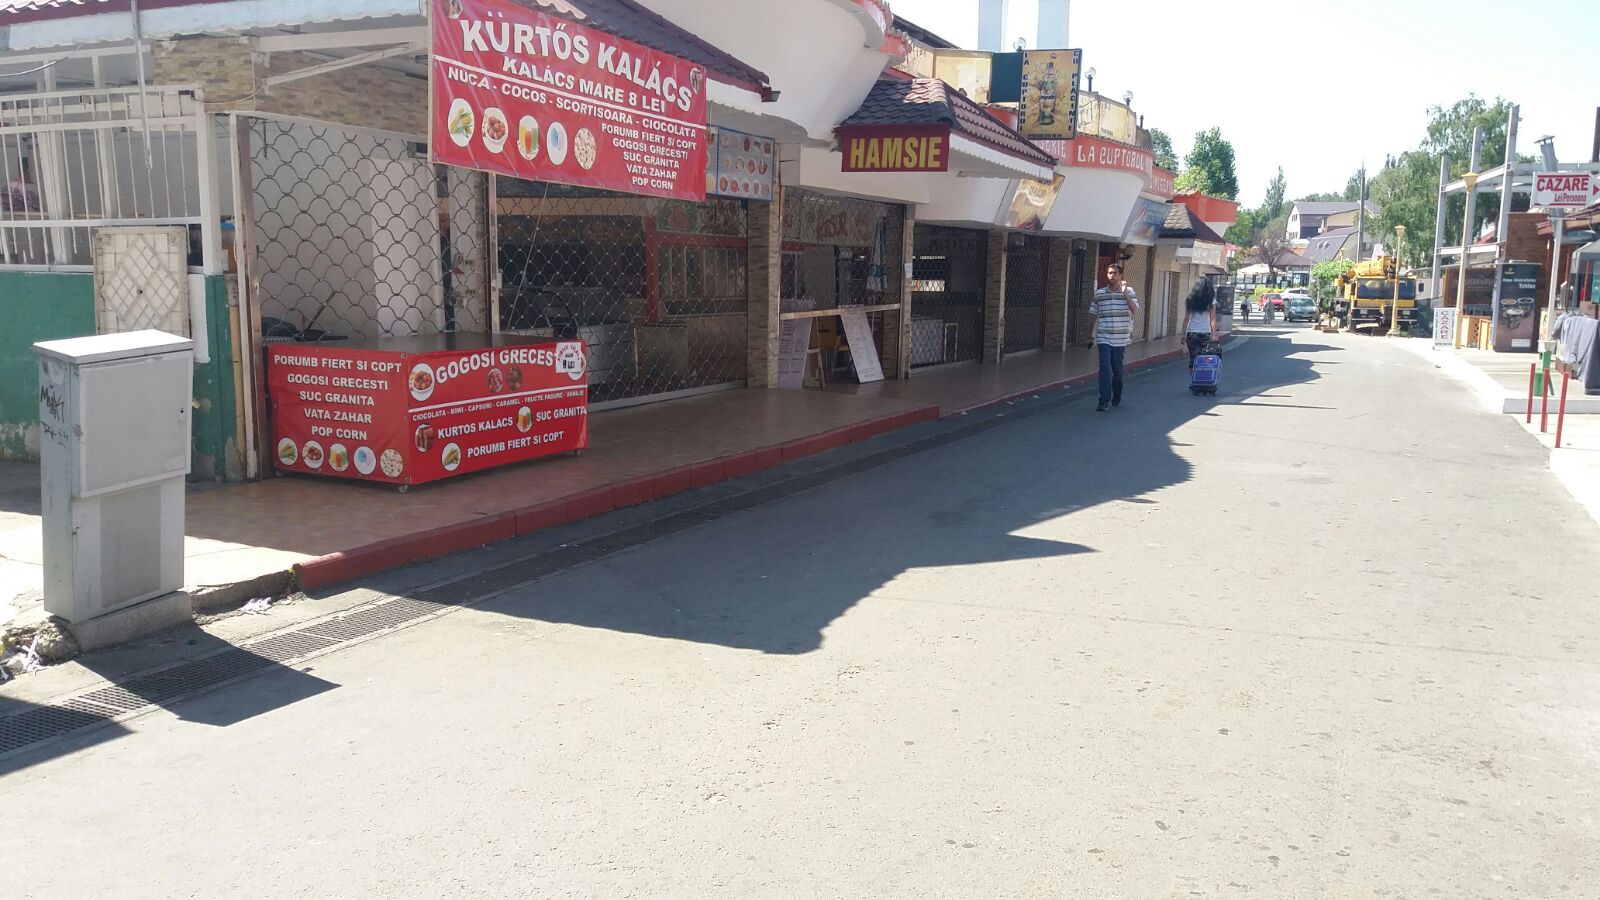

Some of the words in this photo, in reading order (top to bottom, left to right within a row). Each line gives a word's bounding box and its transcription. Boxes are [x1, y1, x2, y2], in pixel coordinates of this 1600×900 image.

[460, 11, 590, 64] KÜRTŐS
[597, 41, 692, 112] KALÁCS
[502, 56, 574, 90] KALÁCS
[579, 78, 624, 103] MARE
[628, 92, 637, 107] 8
[641, 96, 665, 113] LEI
[448, 67, 490, 90] NUCA
[501, 82, 547, 104] COCOS
[556, 98, 633, 125] SCORTISOARA
[642, 118, 696, 138] CIOCOLATA
[601, 123, 639, 139] PORUMB
[641, 131, 665, 144] FIERT
[667, 138, 674, 146] SI
[676, 140, 697, 150] COPT
[612, 138, 647, 152] GOGOSI
[649, 145, 688, 160] GRECESTI
[849, 136, 942, 169] HAMSIE
[1077, 144, 1095, 163] LA
[623, 151, 641, 162] SUC
[643, 155, 679, 168] GRANITA
[626, 164, 647, 175] VATA
[649, 167, 677, 180] ZAHAR
[632, 176, 649, 185] POP
[650, 179, 674, 190] CORN
[1536, 178, 1589, 192] CAZARE
[274, 354, 318, 367] PORUMB
[322, 358, 353, 370] FIERT
[357, 360, 367, 371] SI
[371, 362, 401, 373] COPT
[436, 351, 495, 384] GOGOSI
[499, 348, 557, 367] GRECES
[562, 359, 567, 369] 8
[287, 373, 329, 386] GOGOSI
[332, 377, 388, 391] GRECESTI
[299, 390, 321, 401] SUC
[325, 393, 375, 406] GRANITA
[304, 408, 331, 419] VATA
[333, 411, 372, 423] ZAHAR
[412, 410, 446, 421] CIOCOLATA
[450, 407, 464, 415] KIWI
[536, 410, 551, 422] SUC
[553, 405, 587, 419] GRANITA
[311, 426, 333, 436] POP
[336, 428, 367, 440] CORN
[438, 423, 476, 439] KURTOS
[478, 416, 513, 431] KALACS
[467, 443, 505, 458] PORUMB
[507, 437, 531, 450] FIERT
[533, 435, 541, 444] SI
[543, 431, 564, 443] COPT
